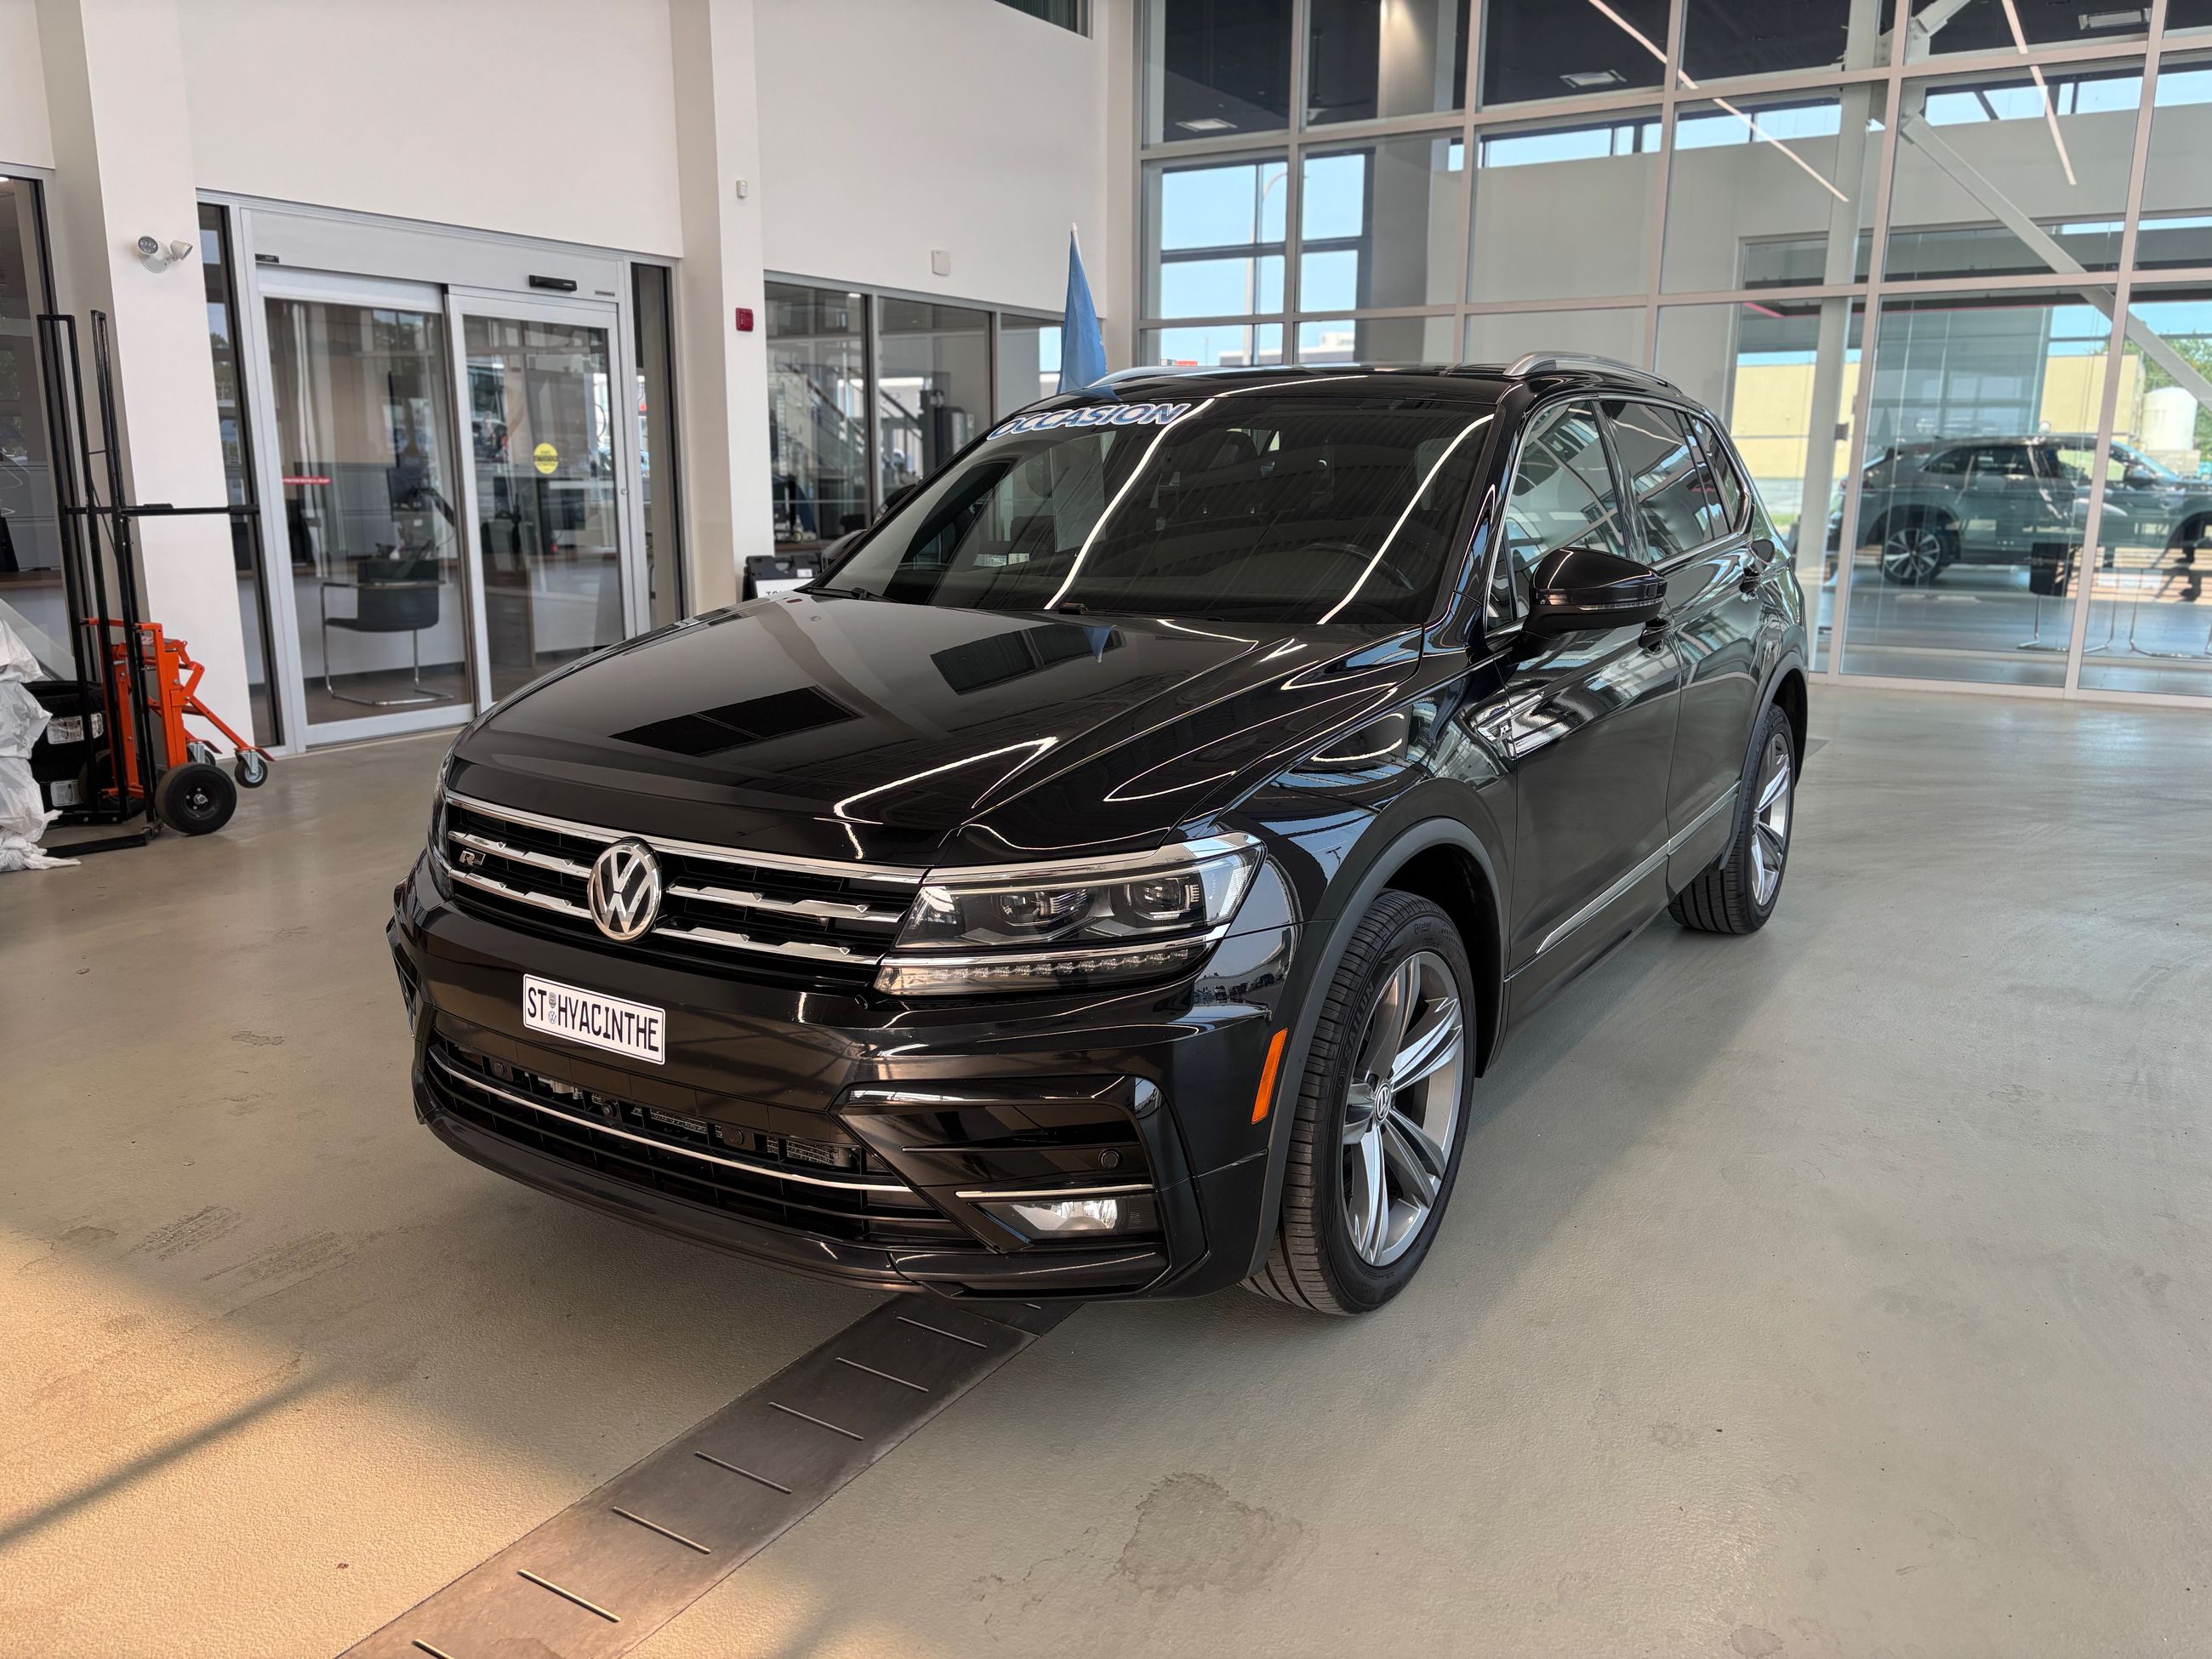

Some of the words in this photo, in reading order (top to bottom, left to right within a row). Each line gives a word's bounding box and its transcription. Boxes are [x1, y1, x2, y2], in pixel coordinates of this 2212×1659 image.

[987, 403, 1191, 440] OCCASION
[527, 987, 547, 1021] ST
[558, 994, 659, 1052] HYACINTHE
[1344, 980, 1375, 1061] SAILUN
